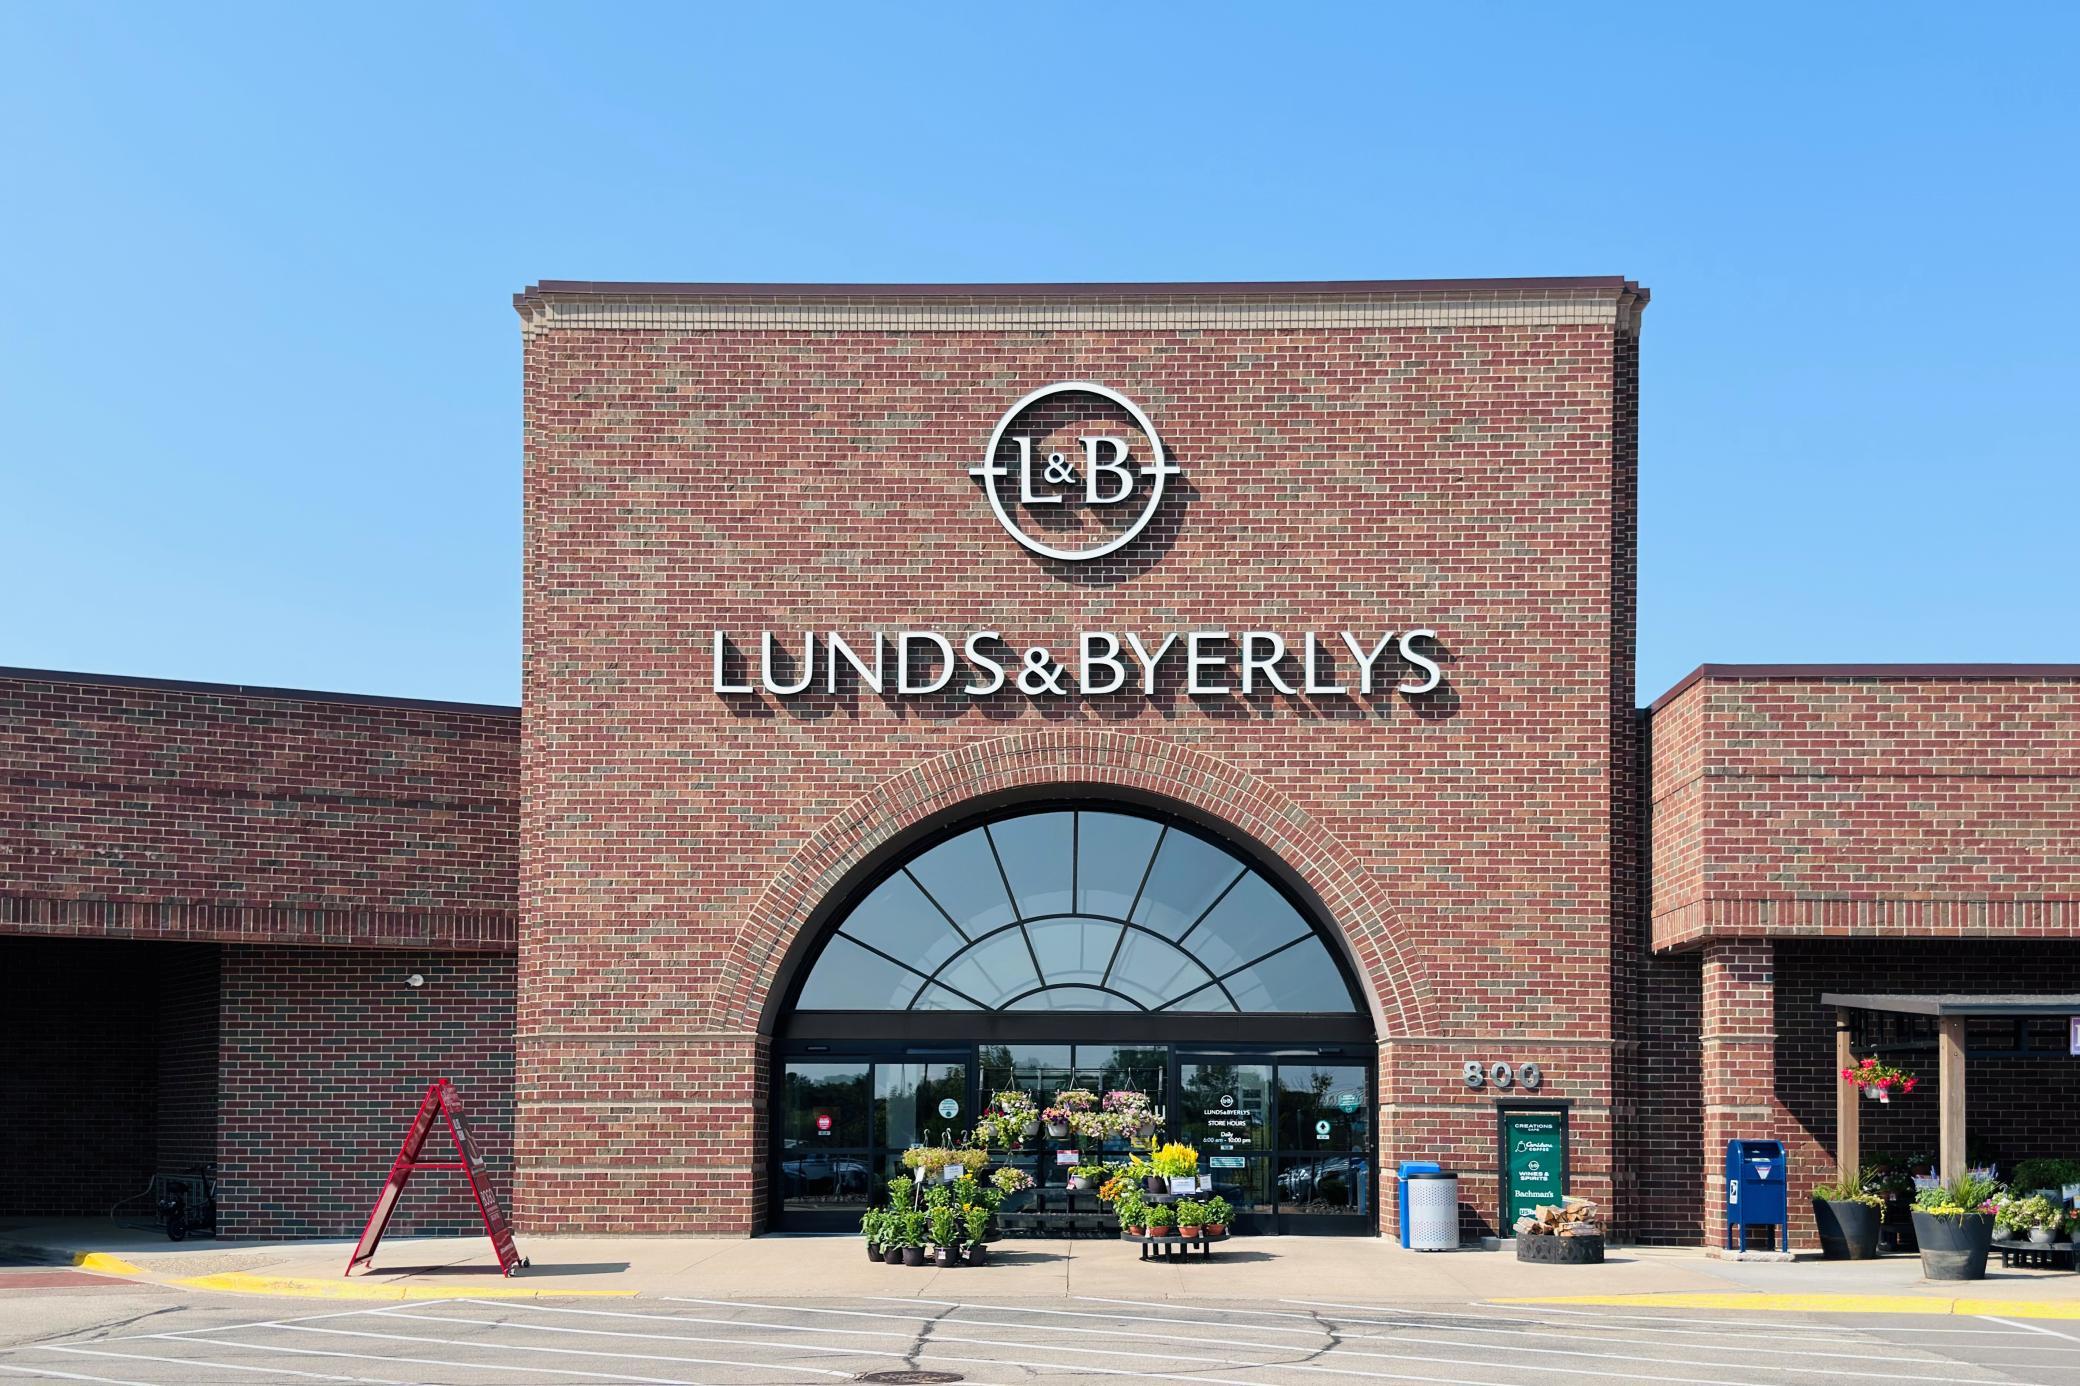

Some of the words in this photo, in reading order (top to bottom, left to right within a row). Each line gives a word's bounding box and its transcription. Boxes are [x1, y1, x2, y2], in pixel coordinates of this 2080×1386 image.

[1012, 435, 1134, 504] L&B
[712, 628, 1442, 696] LUNDS&BYERLYS
[1463, 1061, 1540, 1089] 800
